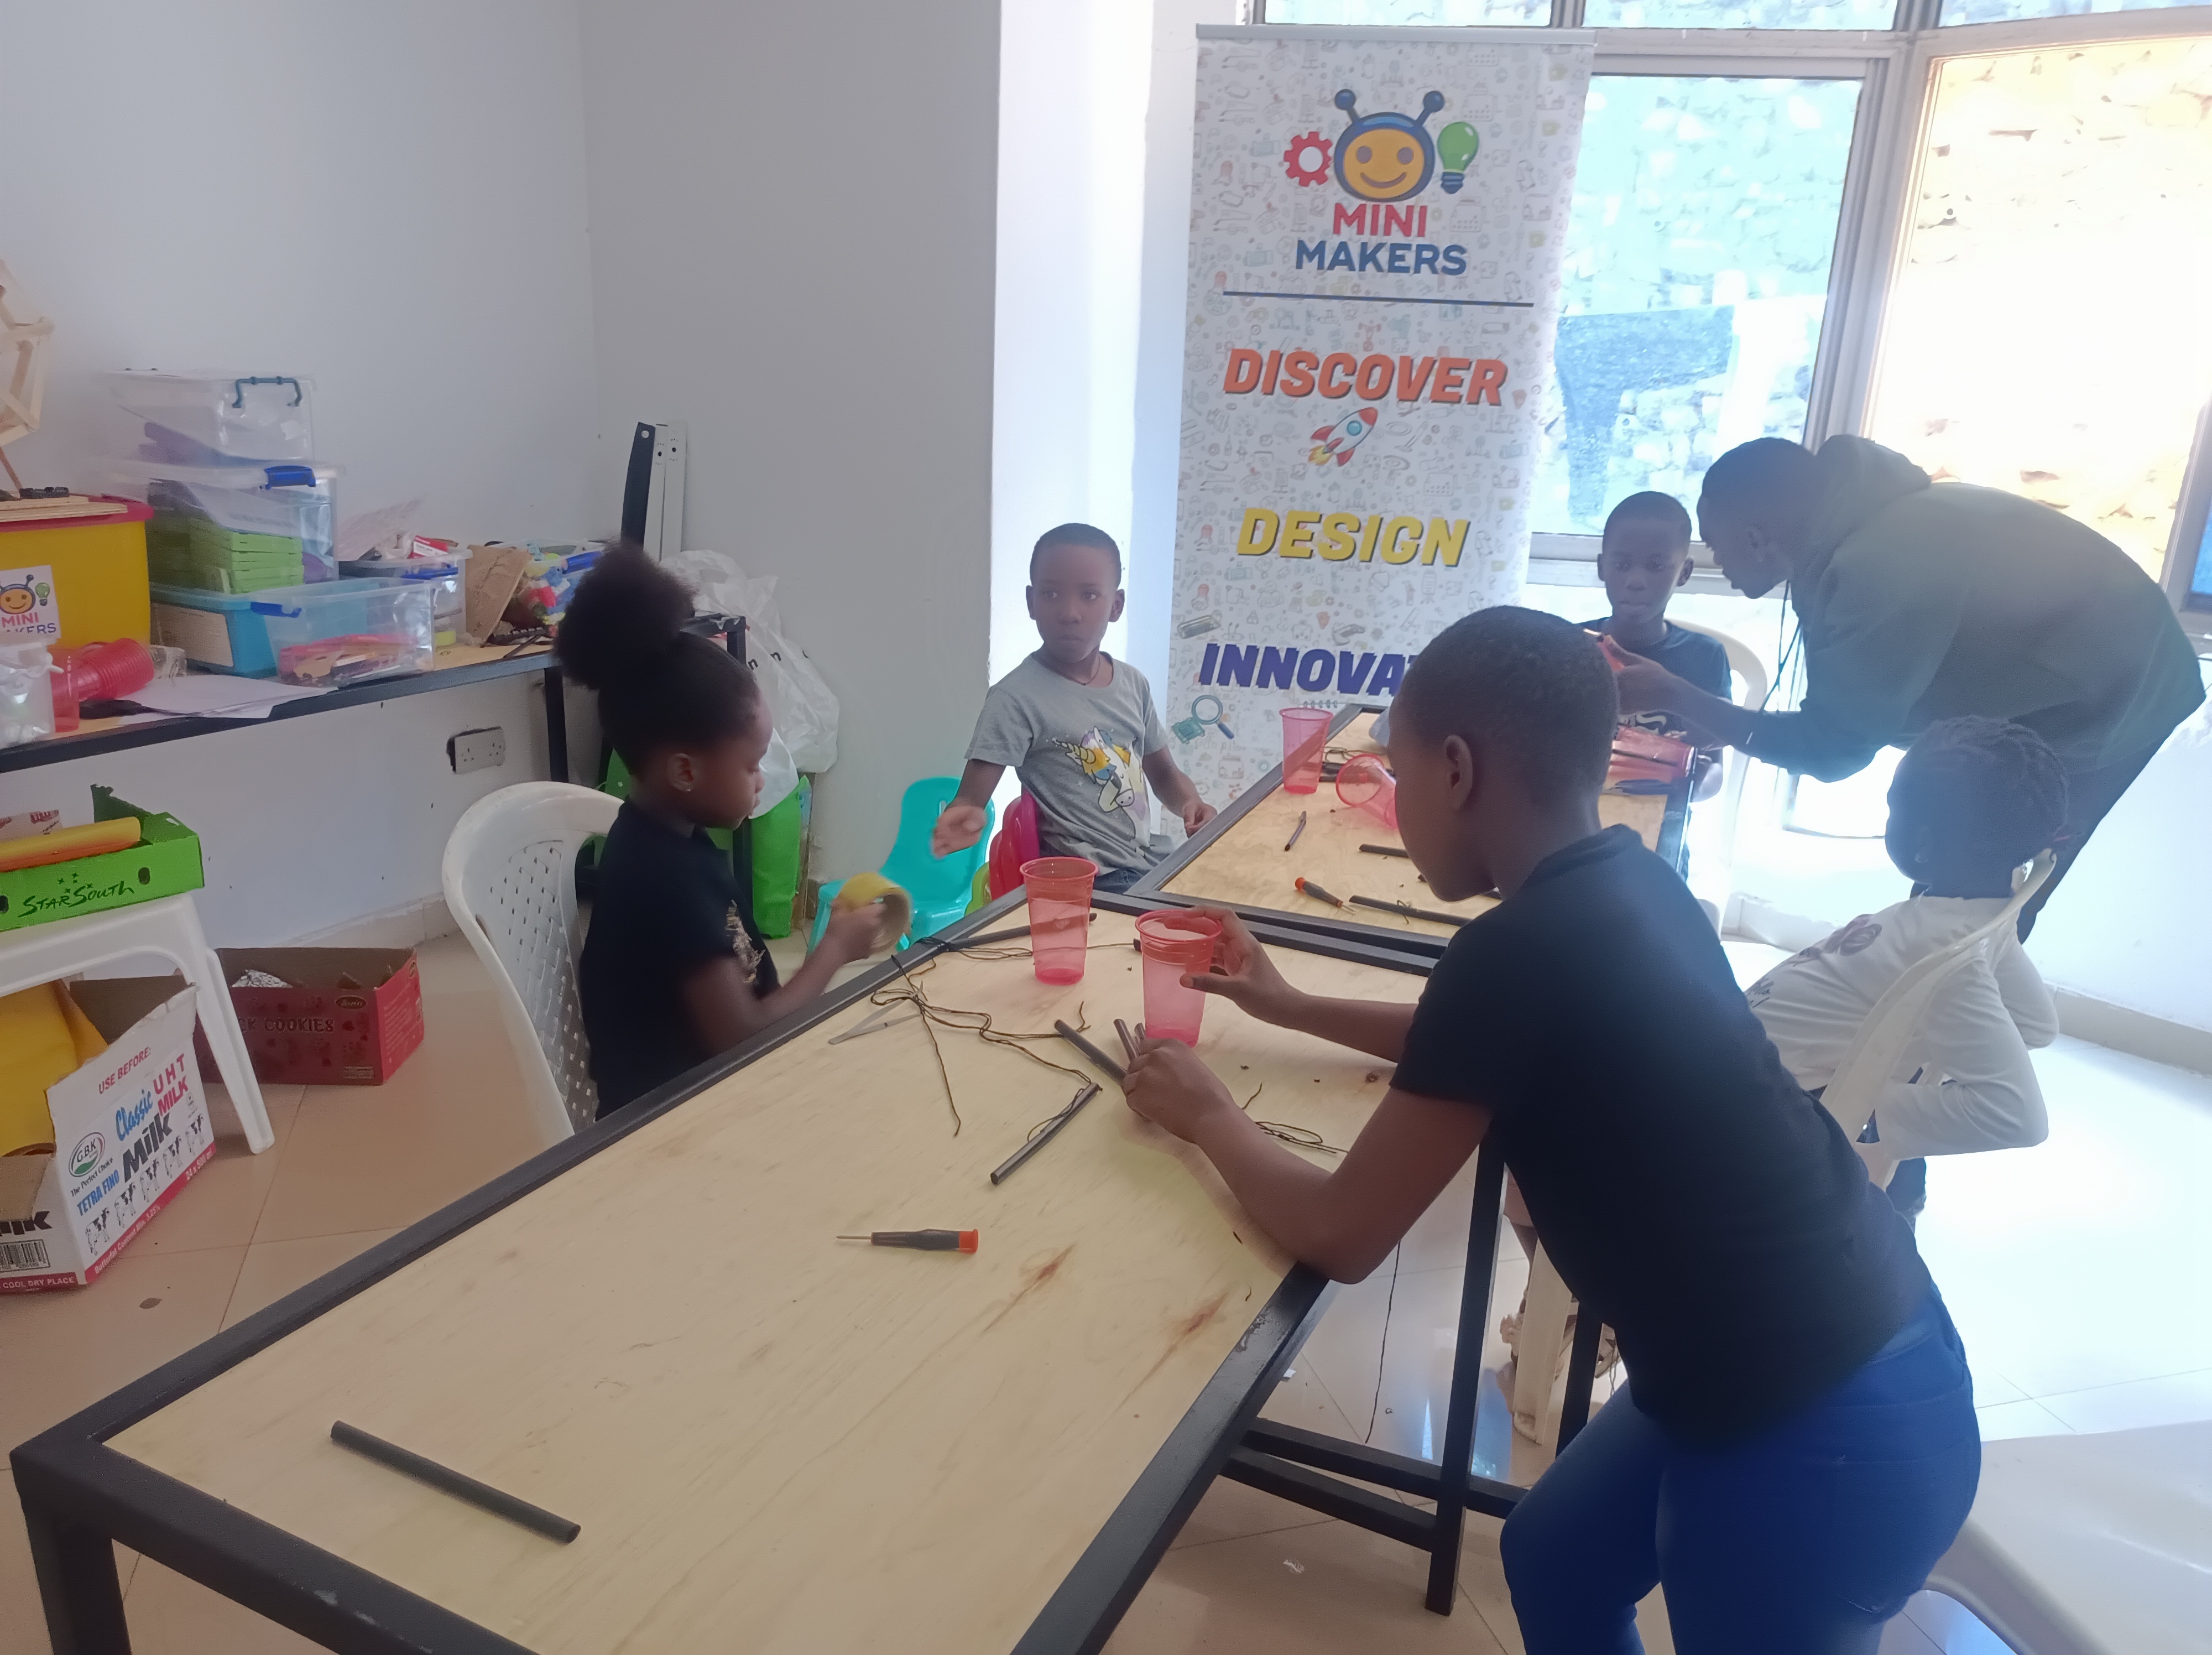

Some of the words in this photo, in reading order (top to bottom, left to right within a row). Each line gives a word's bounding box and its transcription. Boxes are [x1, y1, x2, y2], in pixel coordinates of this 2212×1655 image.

[1333, 202, 1427, 238] MINI
[1295, 240, 1467, 275] MAKERS
[1223, 348, 1508, 407] DISCOVER
[1237, 507, 1469, 567] DESIGN
[1, 612, 39, 628] MINI
[1198, 643, 1420, 697] INNOVA
[263, 1016, 335, 1033] COOKIES
[98, 1073, 116, 1095] USE
[116, 1089, 153, 1142] Classic
[158, 1075, 189, 1117] MILK
[122, 1112, 173, 1183] Milk
[76, 1185, 103, 1216] TETRA
[47, 1277, 75, 1285] PLACE
